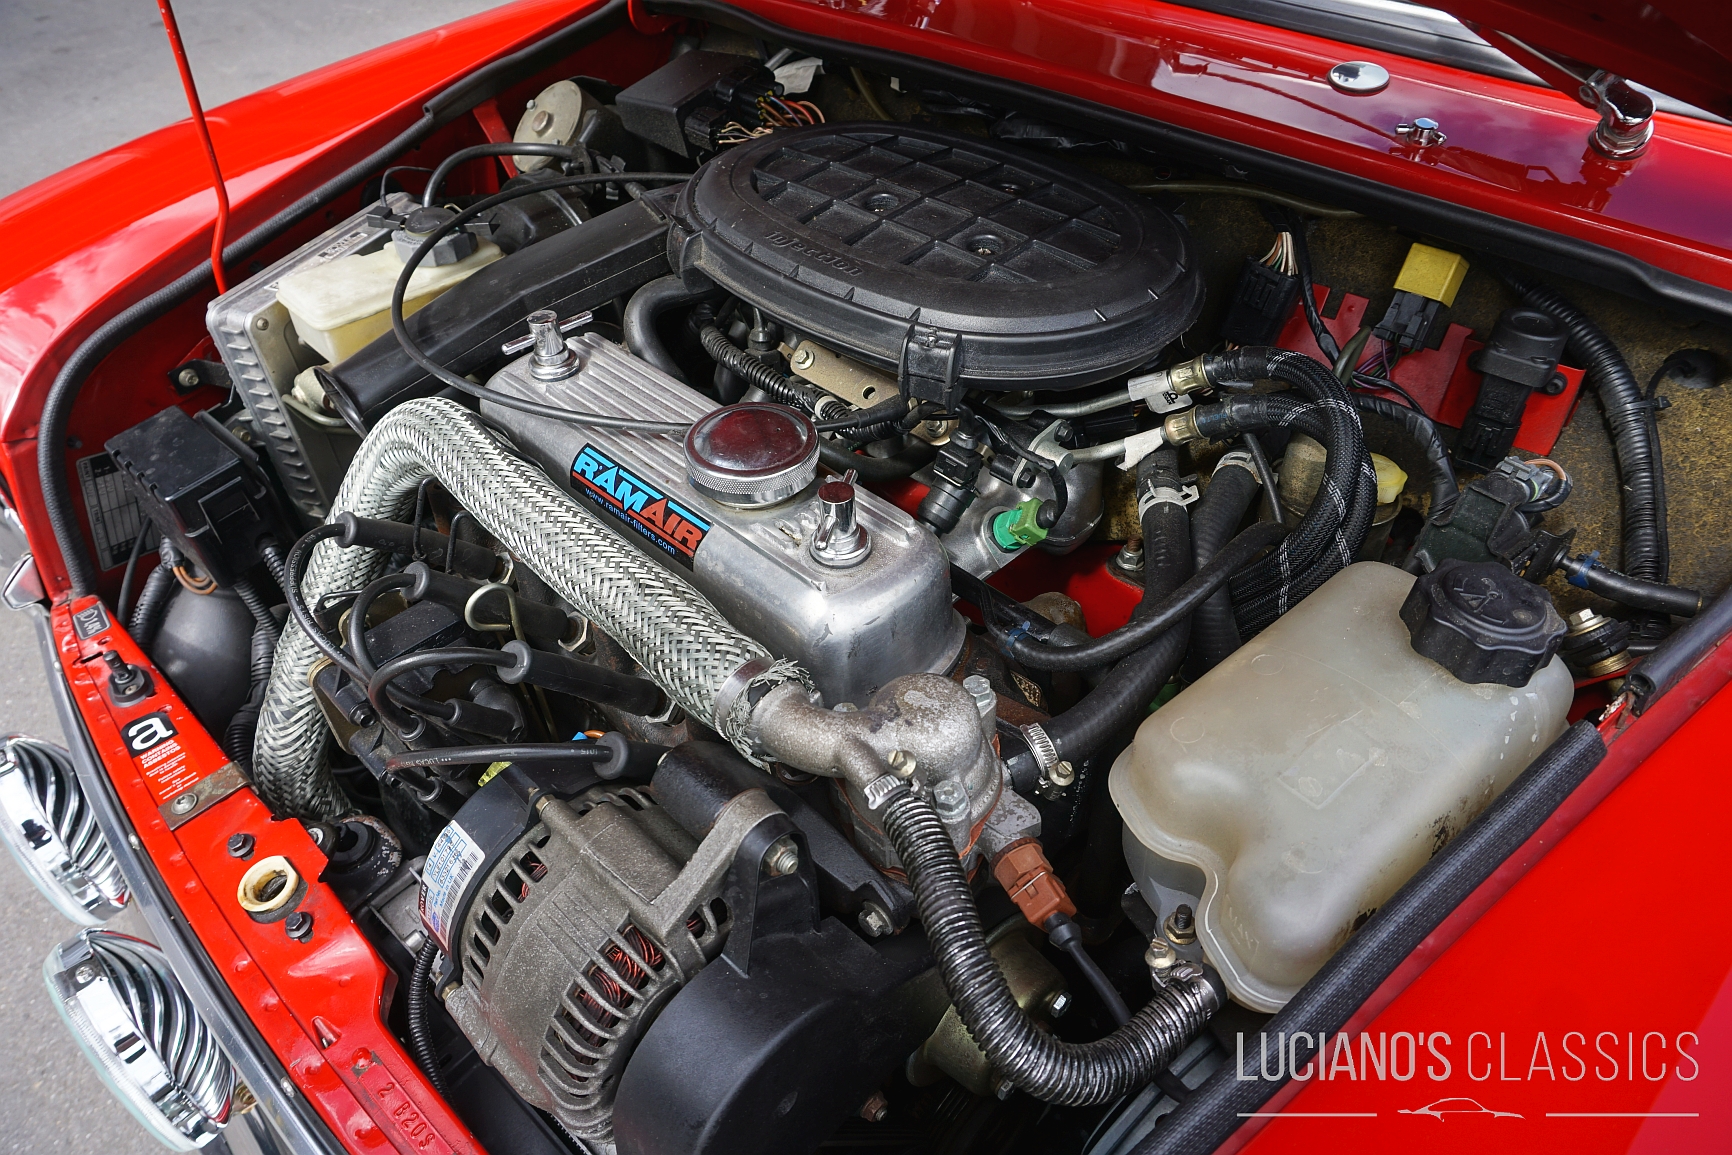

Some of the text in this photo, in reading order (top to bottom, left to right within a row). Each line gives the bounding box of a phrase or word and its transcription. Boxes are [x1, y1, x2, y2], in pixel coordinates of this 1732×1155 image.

[573, 452, 703, 550] RAMAIR
[585, 487, 676, 555] www.ramair-filters.com
[289, 549, 302, 594] SUPPRESSION
[313, 627, 336, 652] LUCAS
[140, 739, 175, 760] WARNING
[141, 742, 178, 764] CONTAINS
[143, 745, 181, 769] ASBESTOS
[420, 884, 428, 914] ROVER
[377, 1081, 395, 1099] 2
